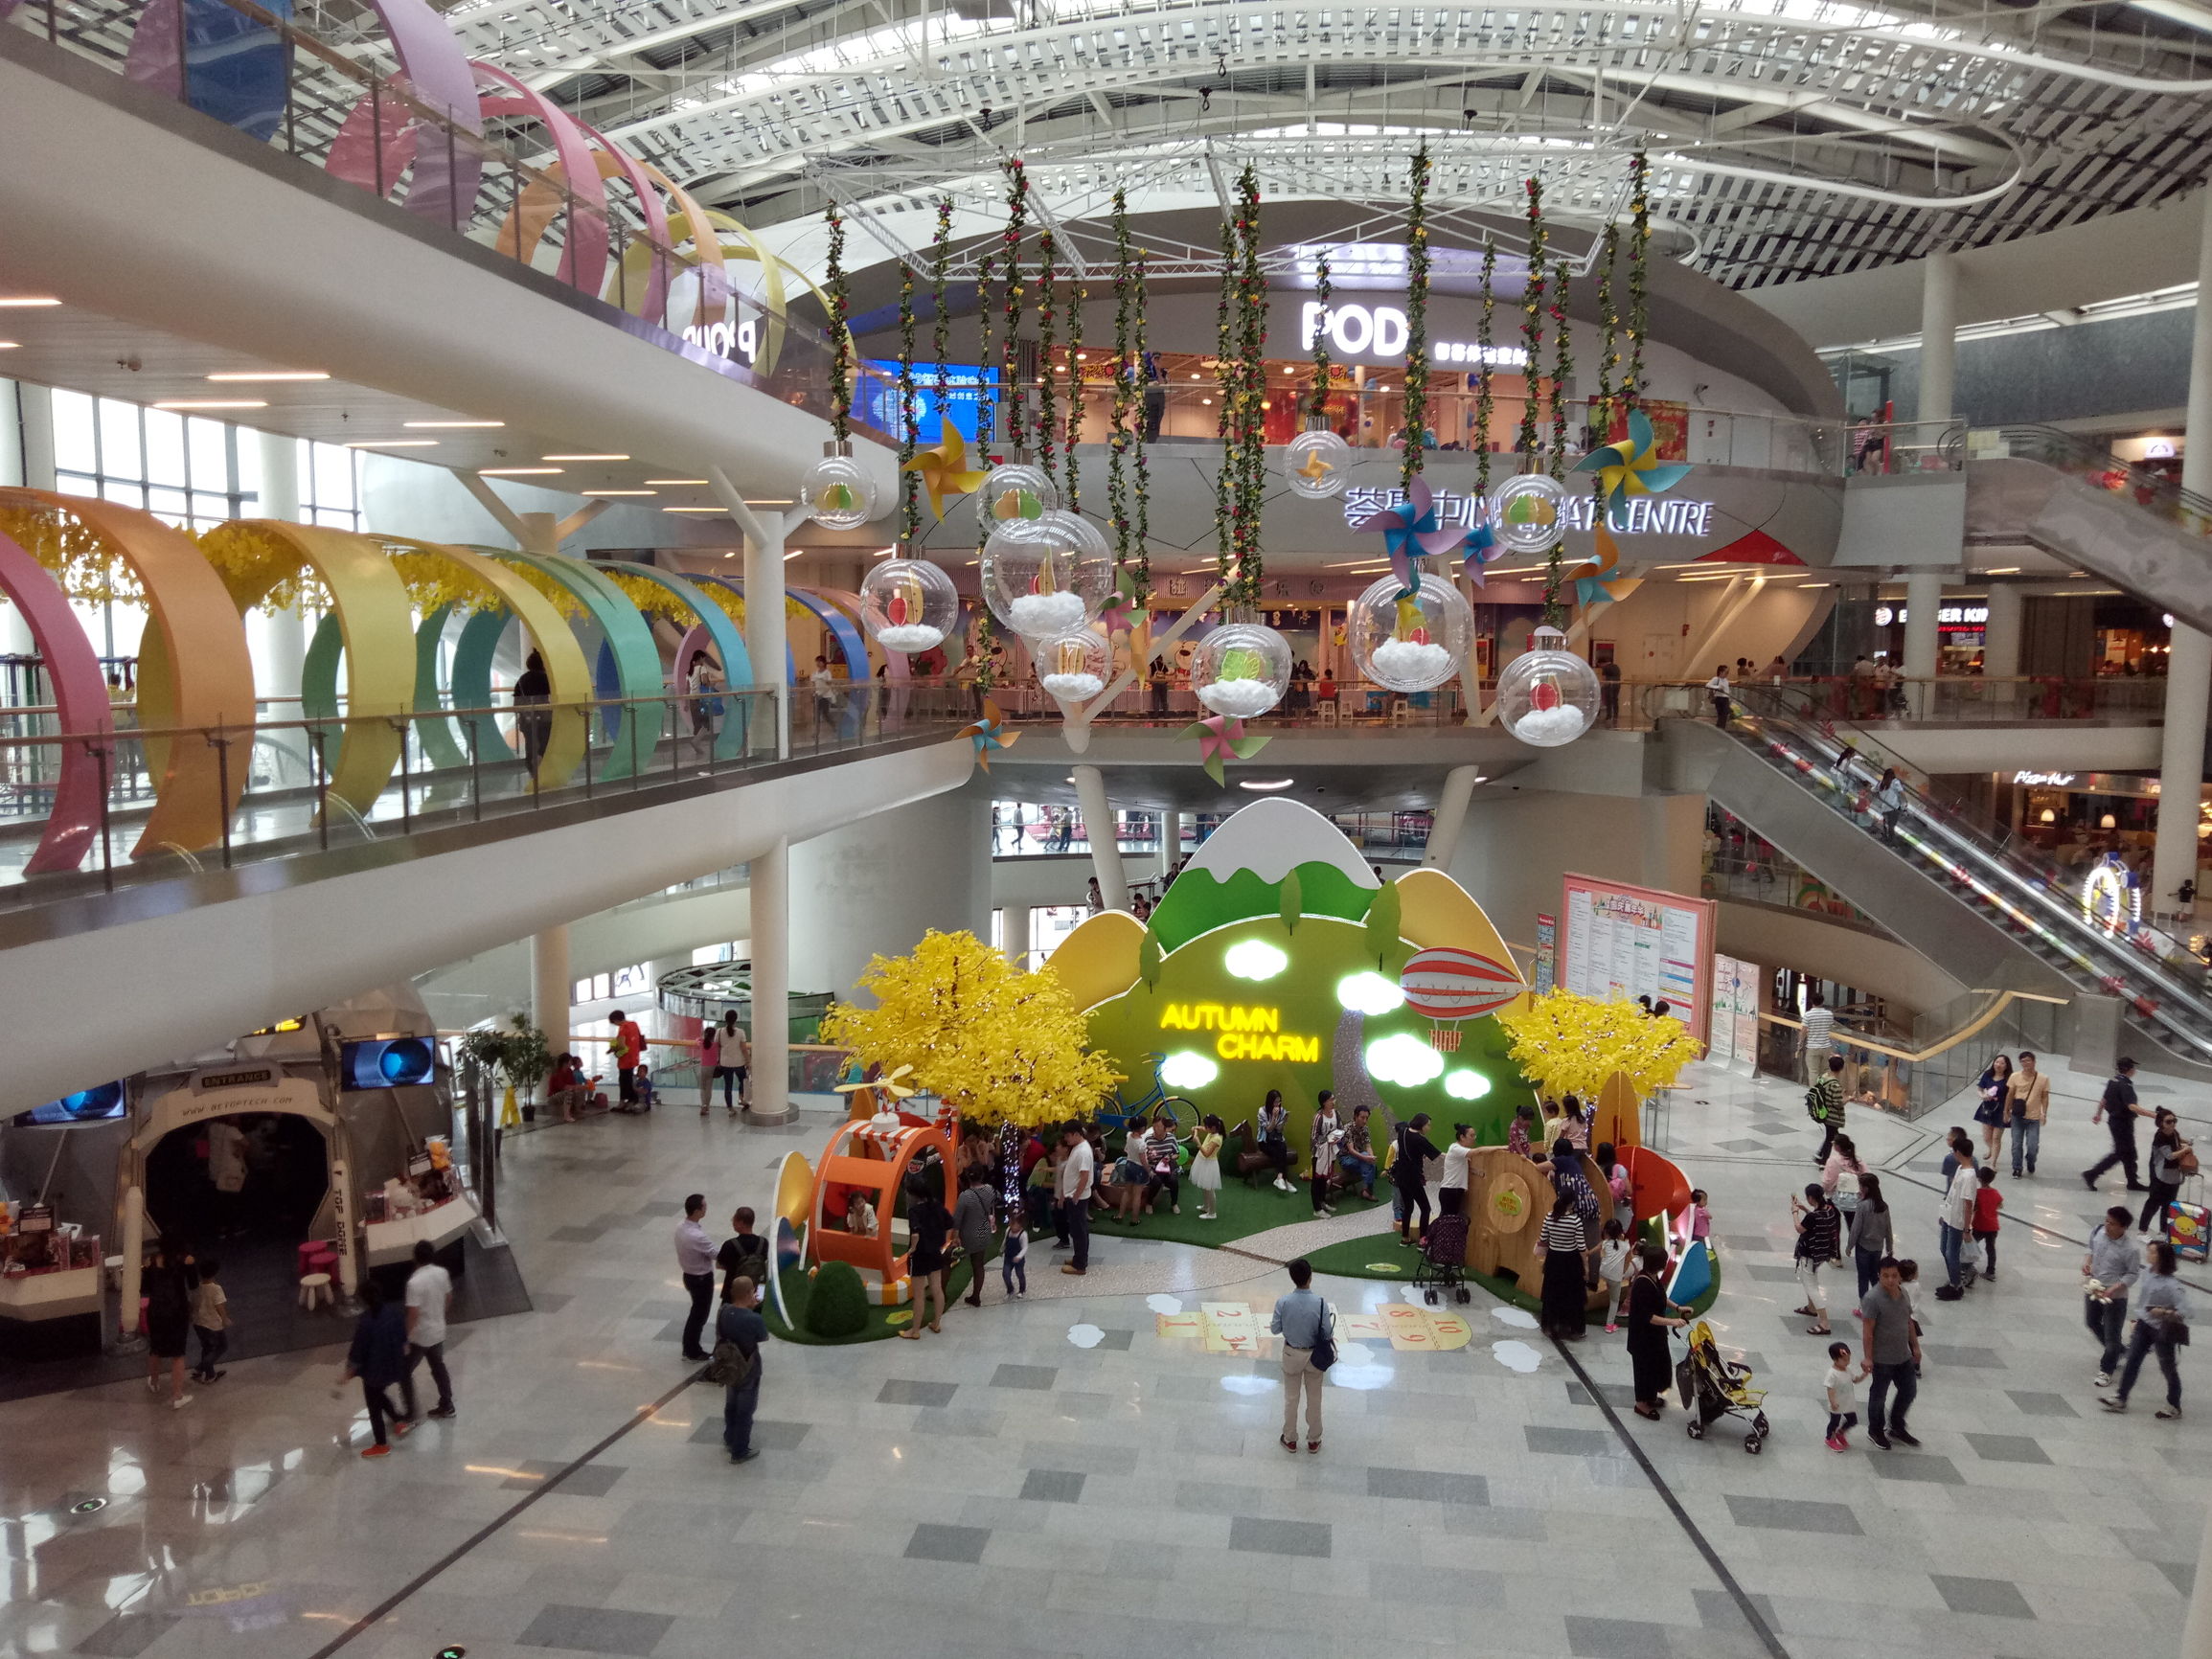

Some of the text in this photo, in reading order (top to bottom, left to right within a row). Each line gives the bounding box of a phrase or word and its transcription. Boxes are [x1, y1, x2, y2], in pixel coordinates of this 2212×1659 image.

[1302, 301, 1410, 357] POD
[1607, 498, 1716, 537] CENTRE
[2013, 770, 2075, 786] Pizza Hut
[1159, 1003, 1279, 1034] AUTUMN
[1216, 1034, 1319, 1063] CHARM
[203, 1070, 270, 1088] ENTRANCE
[1389, 1309, 1415, 1318] 8
